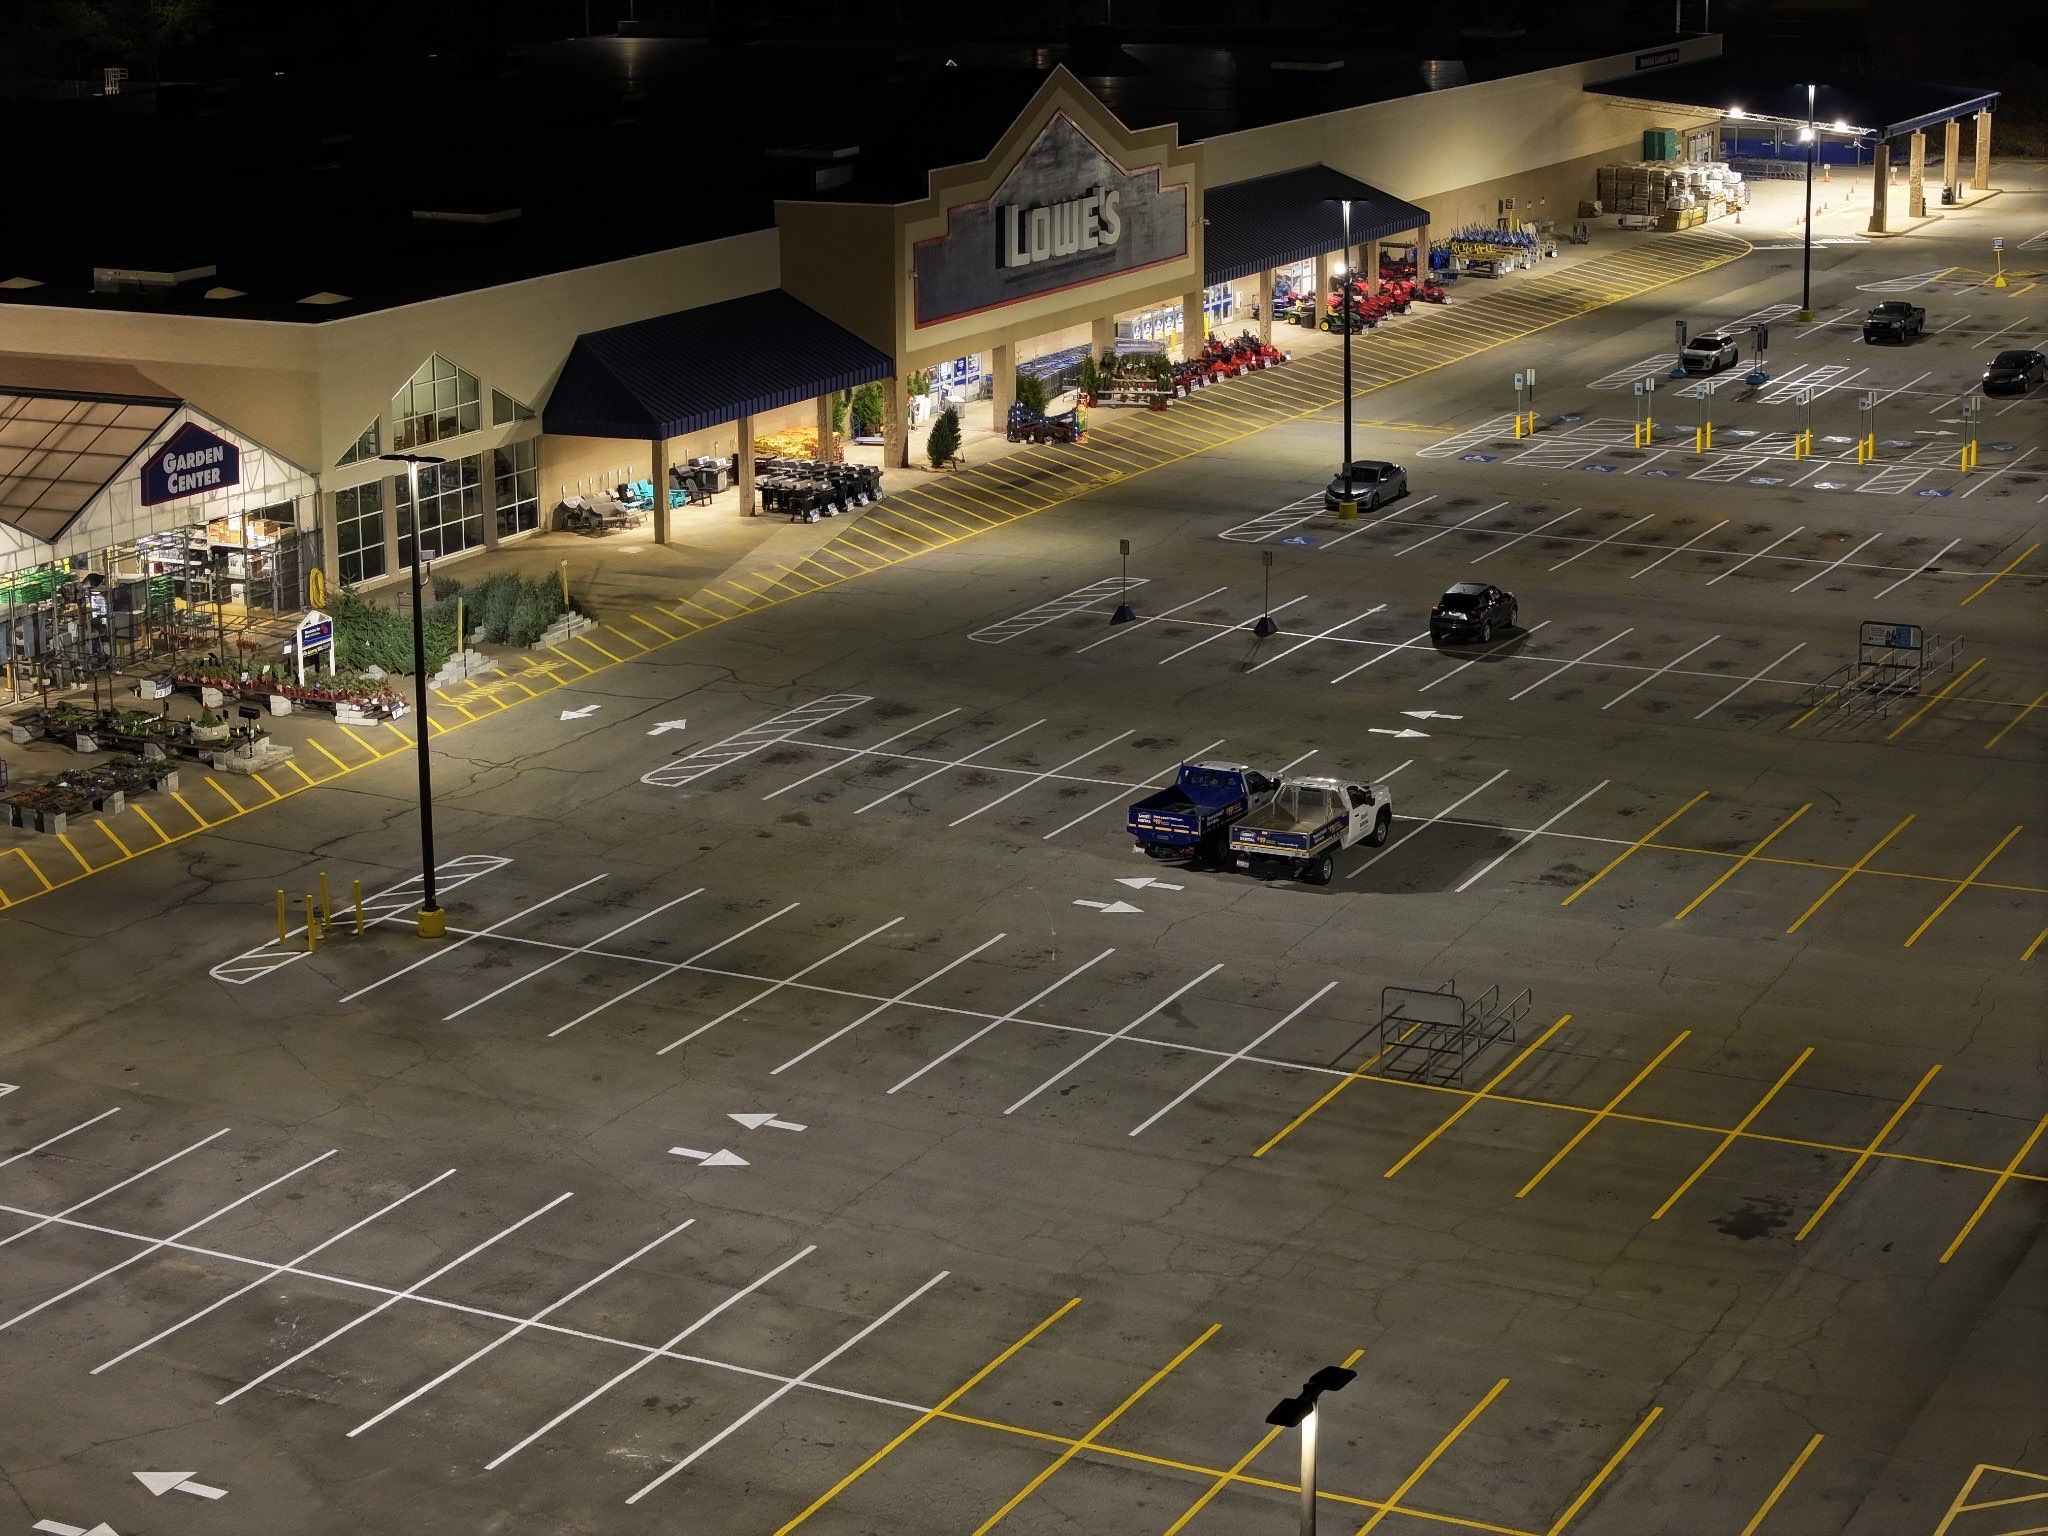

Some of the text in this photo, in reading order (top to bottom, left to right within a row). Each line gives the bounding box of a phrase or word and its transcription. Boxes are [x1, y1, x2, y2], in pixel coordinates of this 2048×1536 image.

[1005, 186, 1121, 269] LOWE'S
[162, 445, 224, 474] GARDEN
[167, 467, 221, 494] CENTER
